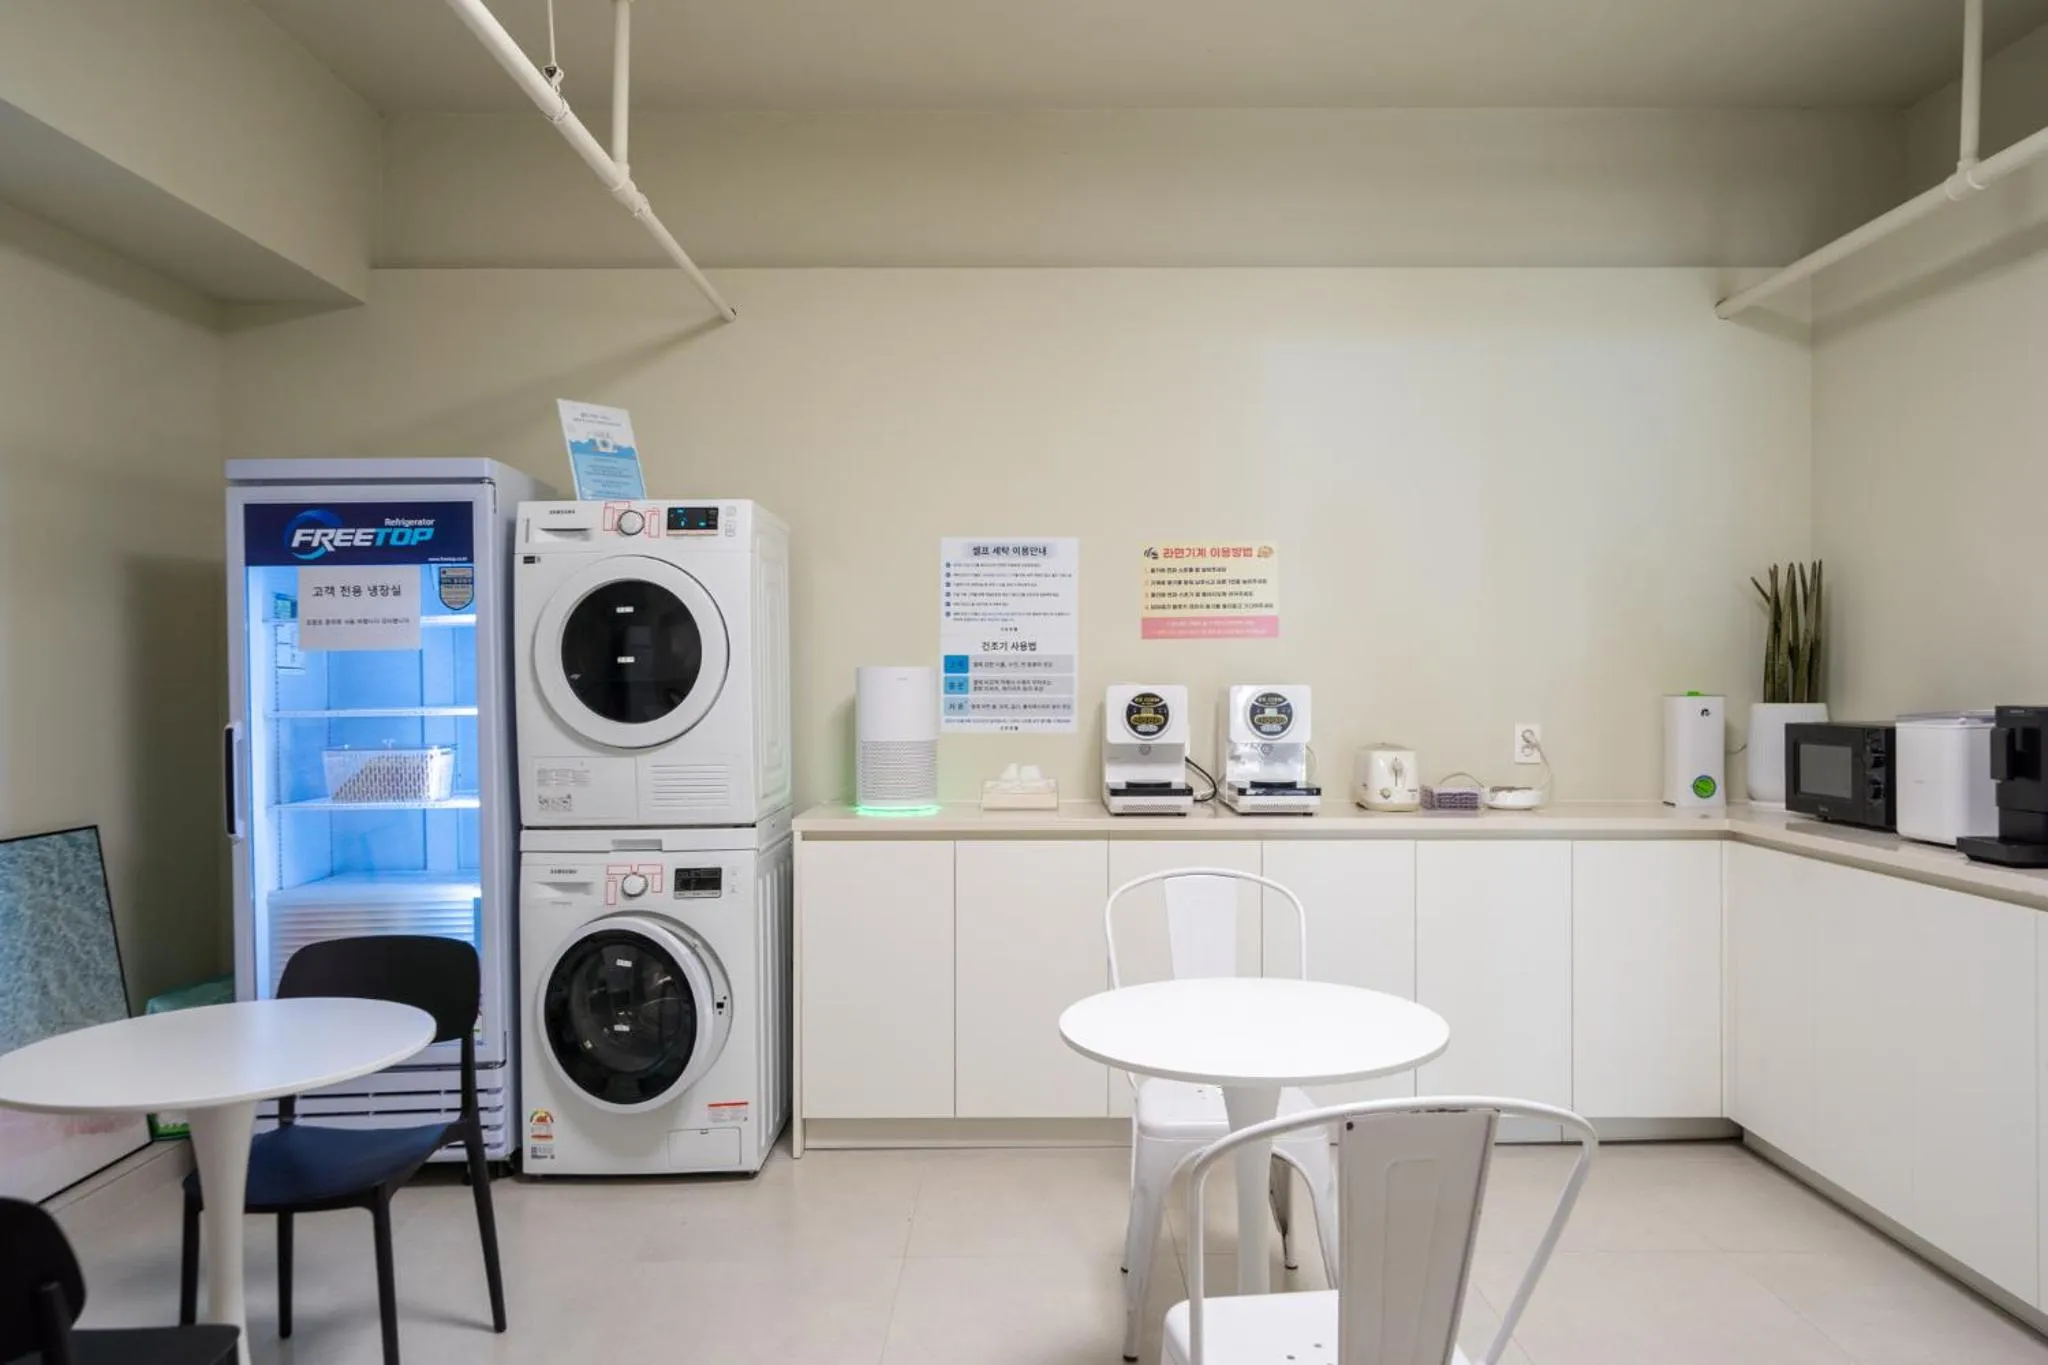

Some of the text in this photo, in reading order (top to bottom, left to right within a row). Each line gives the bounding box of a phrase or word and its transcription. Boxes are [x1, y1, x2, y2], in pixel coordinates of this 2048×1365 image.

[384, 518, 436, 529] Refrigerator
[291, 528, 436, 552] FREETOP
[972, 546, 1047, 556] 셀프 세탁 이용안내
[1162, 547, 1253, 559] 라면기계 이용방법
[312, 584, 401, 598] 고객 전용 냉장실
[982, 641, 1037, 652] 건조기 사용법
